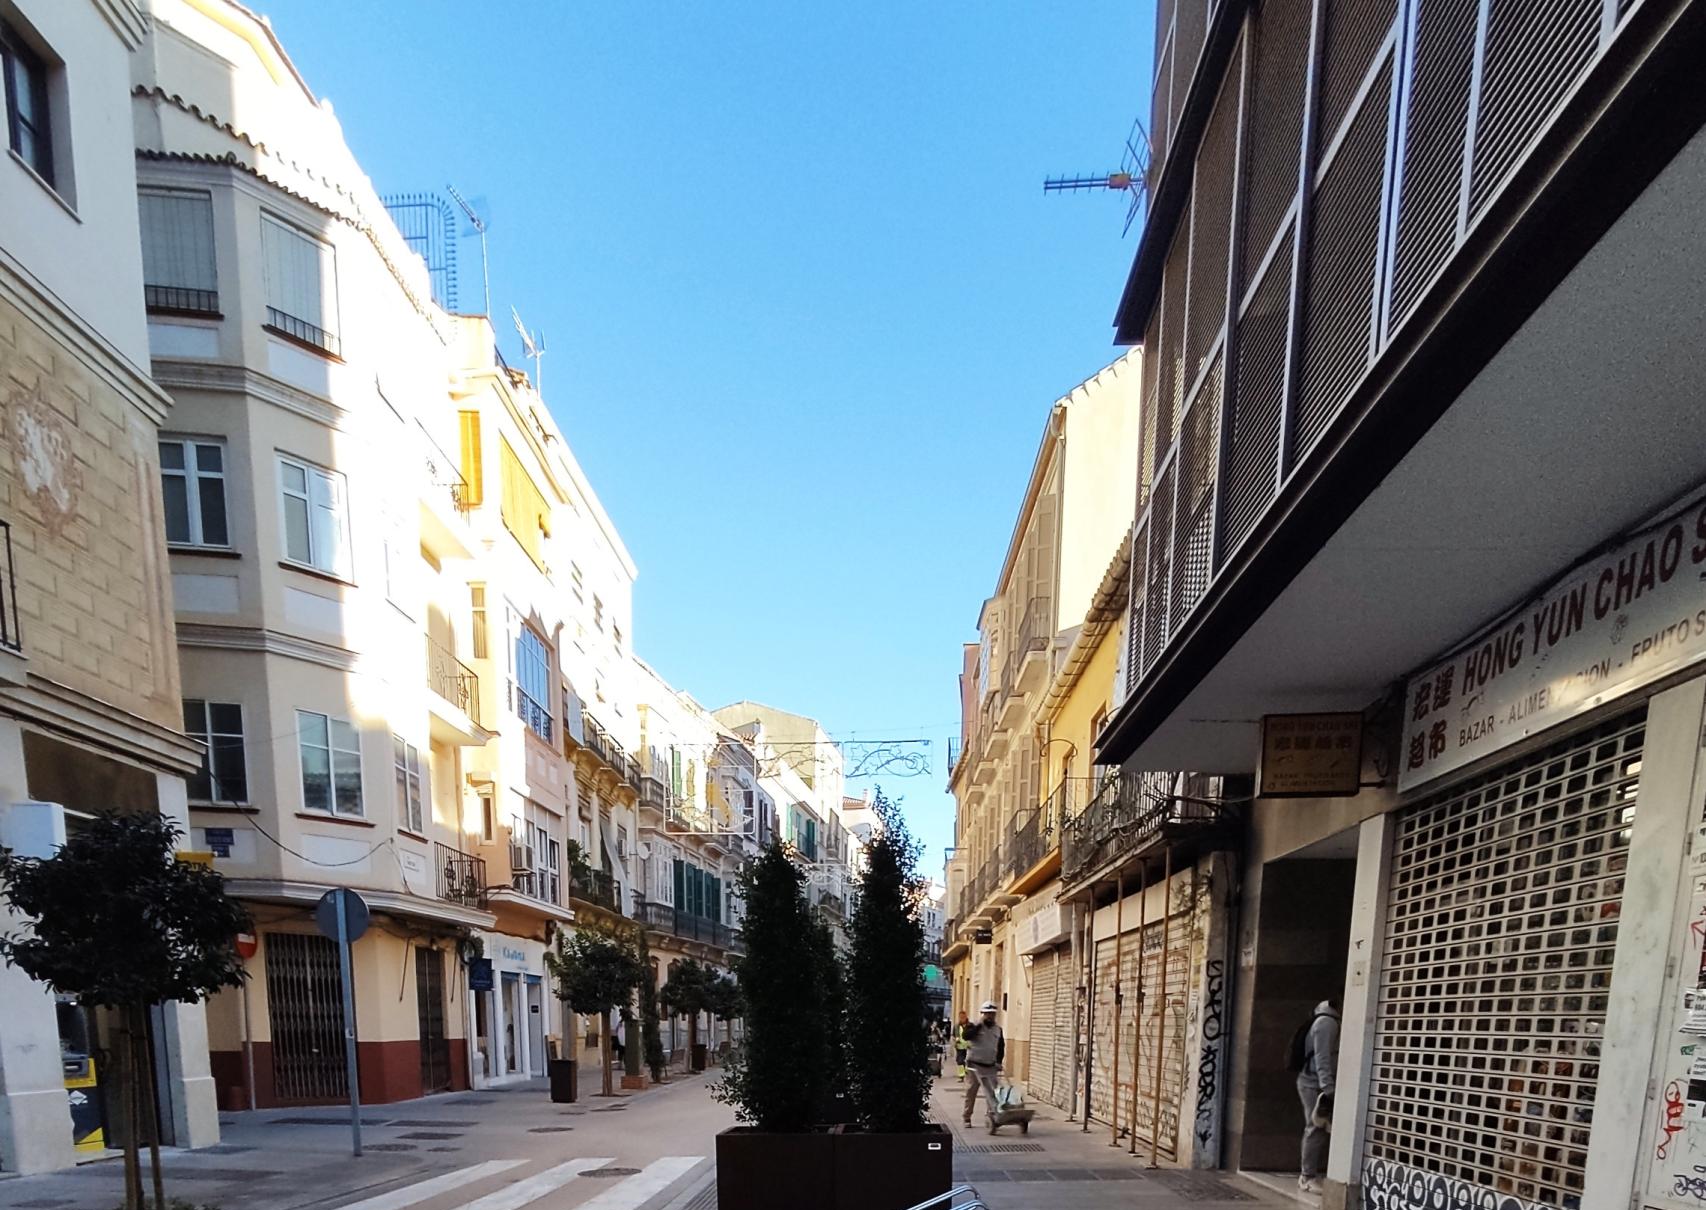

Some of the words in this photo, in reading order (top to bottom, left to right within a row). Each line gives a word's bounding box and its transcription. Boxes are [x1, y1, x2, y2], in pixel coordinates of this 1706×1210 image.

[1461, 622, 1525, 696] HONG
[1532, 583, 1588, 655] YUN
[1594, 524, 1684, 621] CHAO
[1458, 715, 1495, 748] BAZAR
